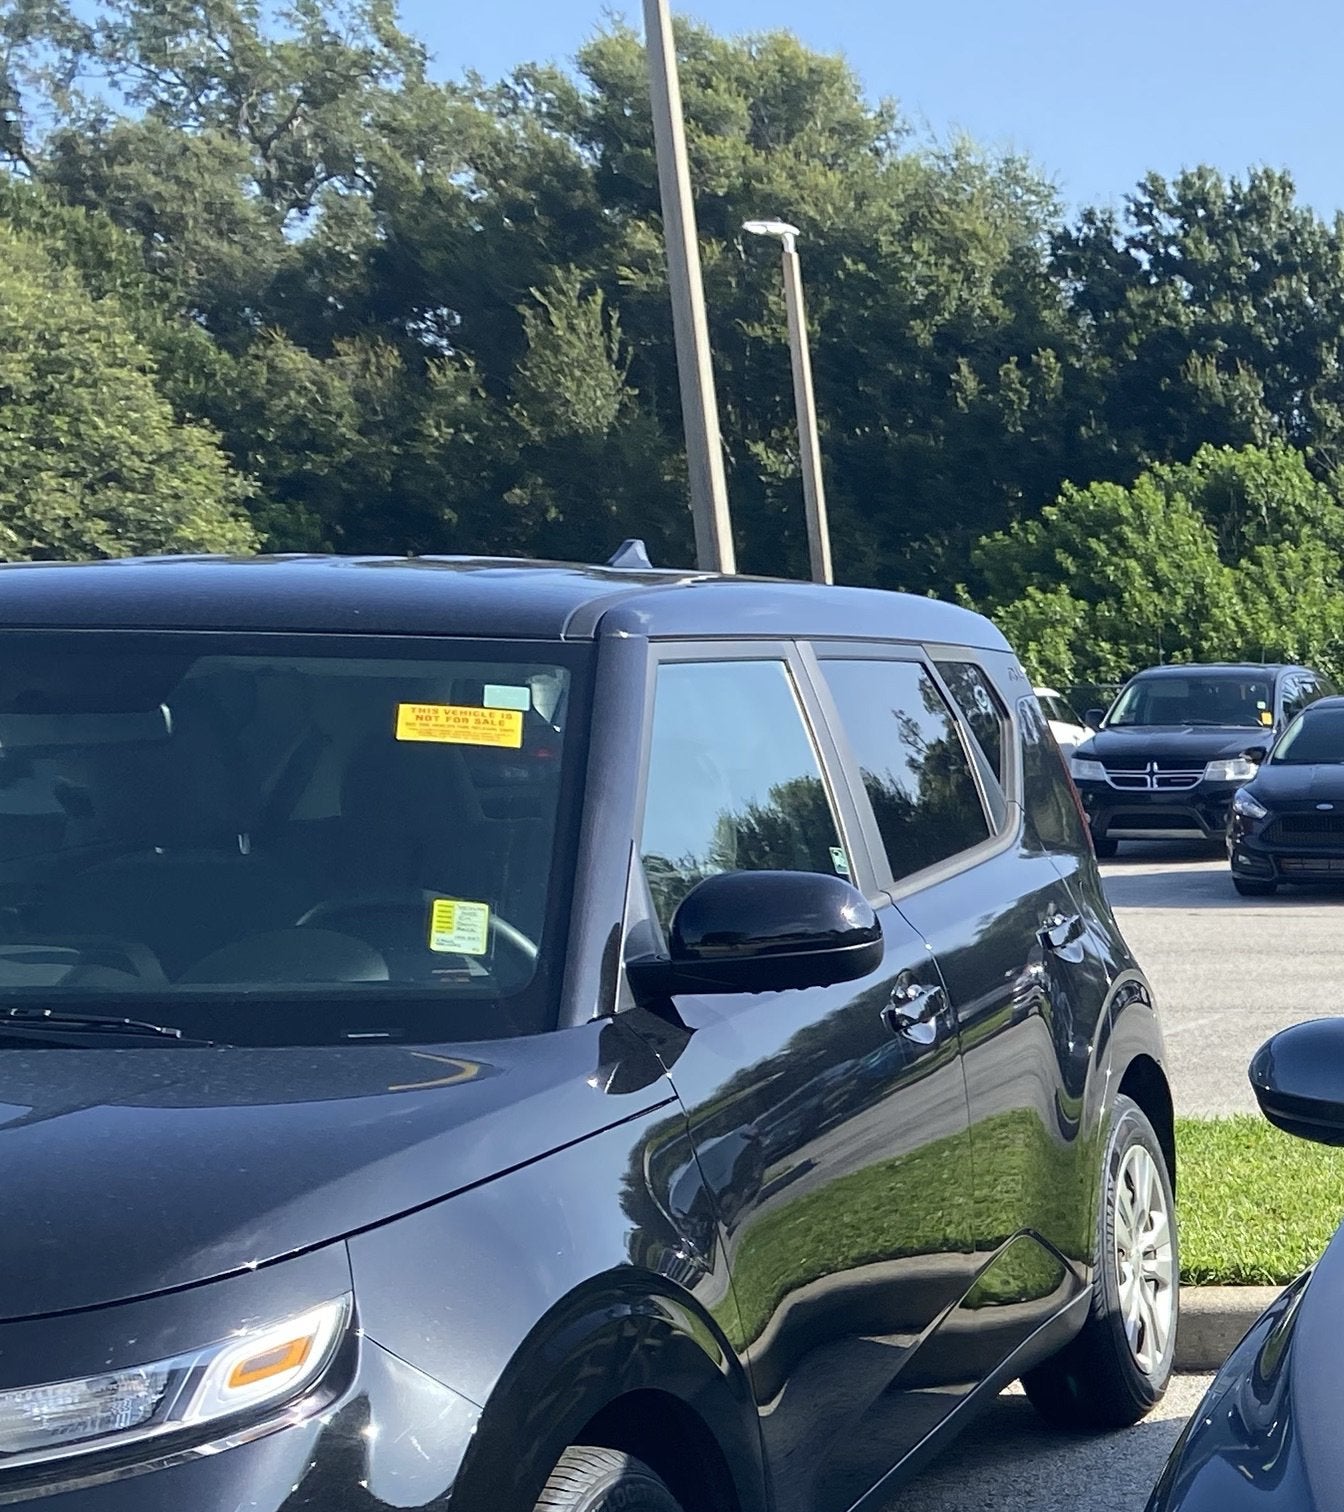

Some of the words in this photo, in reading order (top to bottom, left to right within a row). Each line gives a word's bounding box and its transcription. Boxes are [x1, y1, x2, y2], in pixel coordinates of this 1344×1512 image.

[410, 706, 440, 715] THIS
[444, 708, 496, 719] VEHICLE
[500, 712, 513, 720] IS
[415, 714, 441, 722] NOT
[474, 718, 506, 727] SALE
